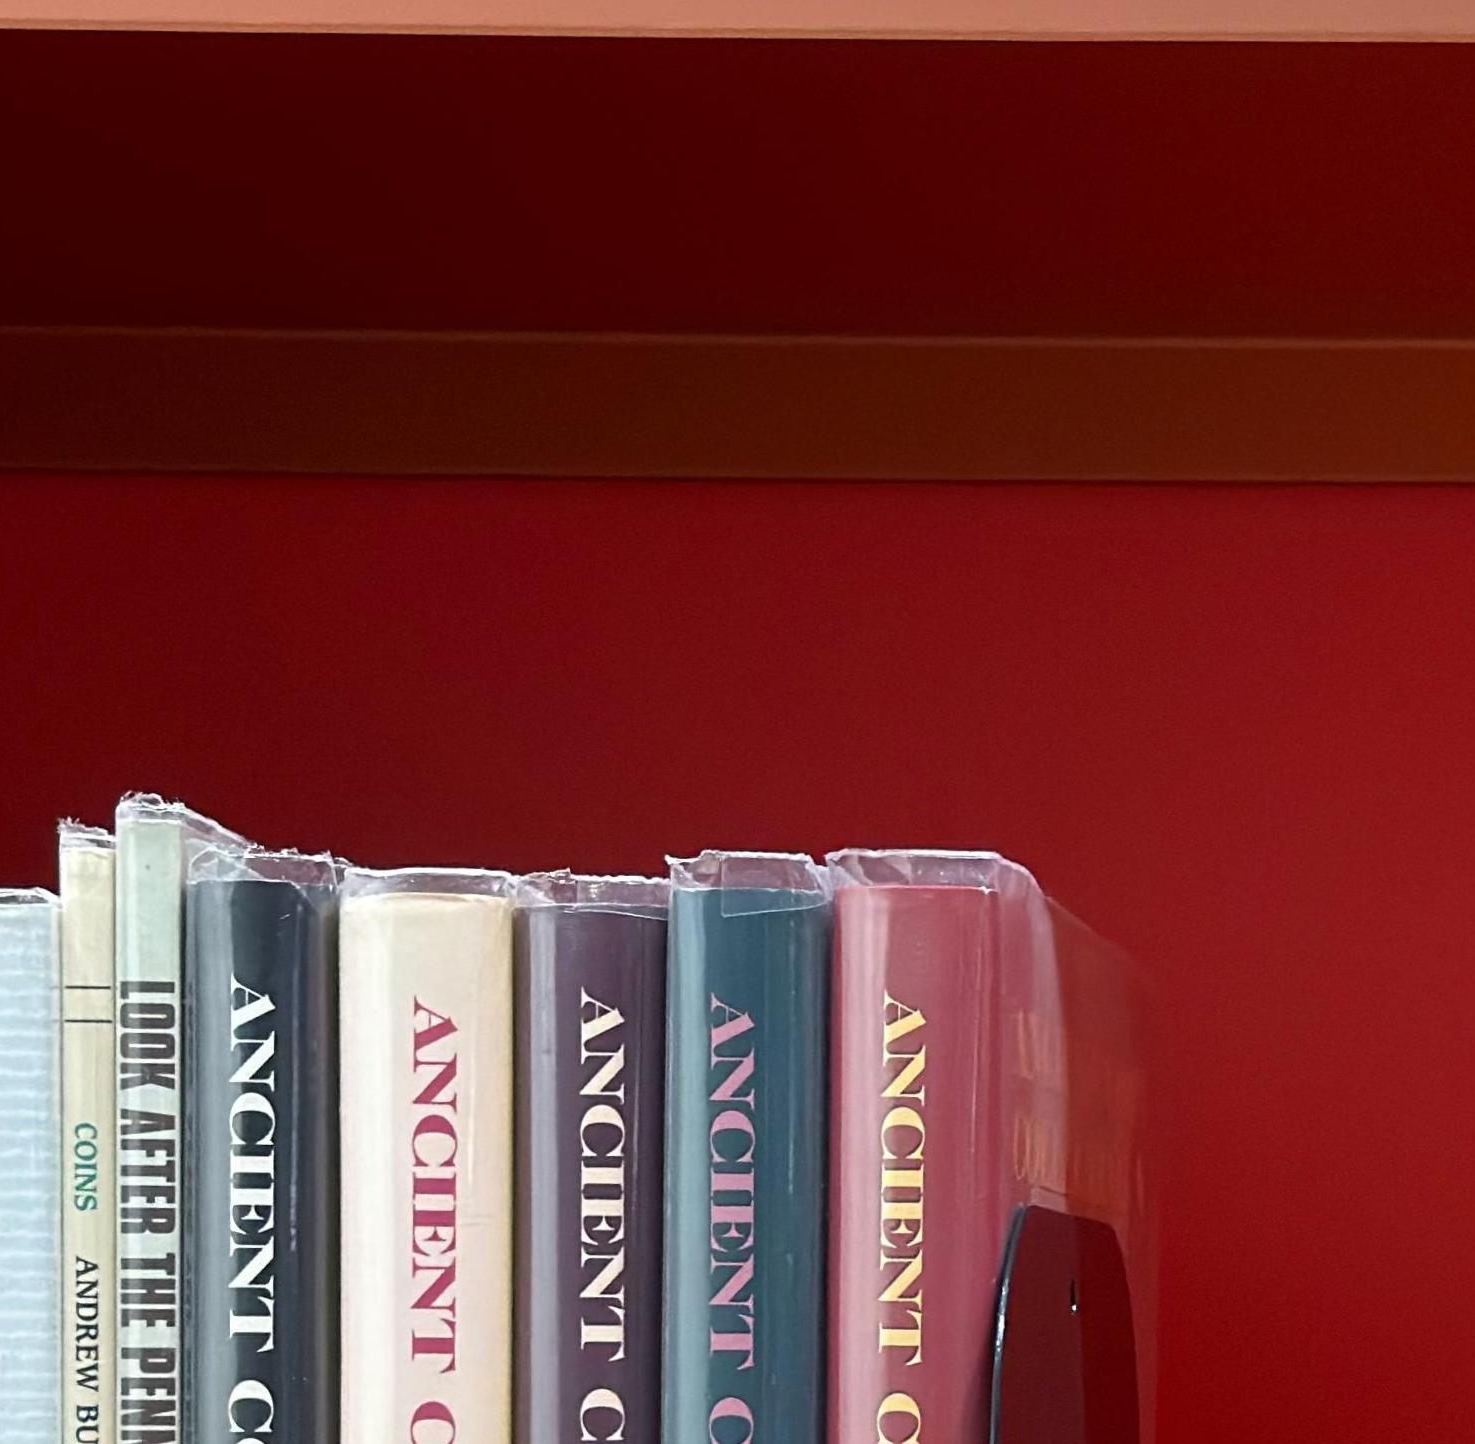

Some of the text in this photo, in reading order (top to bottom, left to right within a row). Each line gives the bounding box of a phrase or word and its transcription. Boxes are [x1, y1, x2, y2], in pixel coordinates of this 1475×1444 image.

[118, 980, 176, 1088] LOOK
[73, 1121, 99, 1212] COINS
[119, 1108, 176, 1235] AFTER
[119, 1252, 176, 1330] THE
[226, 974, 277, 1354] ANCIENT
[410, 995, 459, 1374] ANCIENT
[579, 986, 627, 1363] ANCIENT
[708, 993, 757, 1371] ANCIENT
[878, 992, 928, 1367] ANCIENT
[74, 1256, 101, 1392] ANDREW
